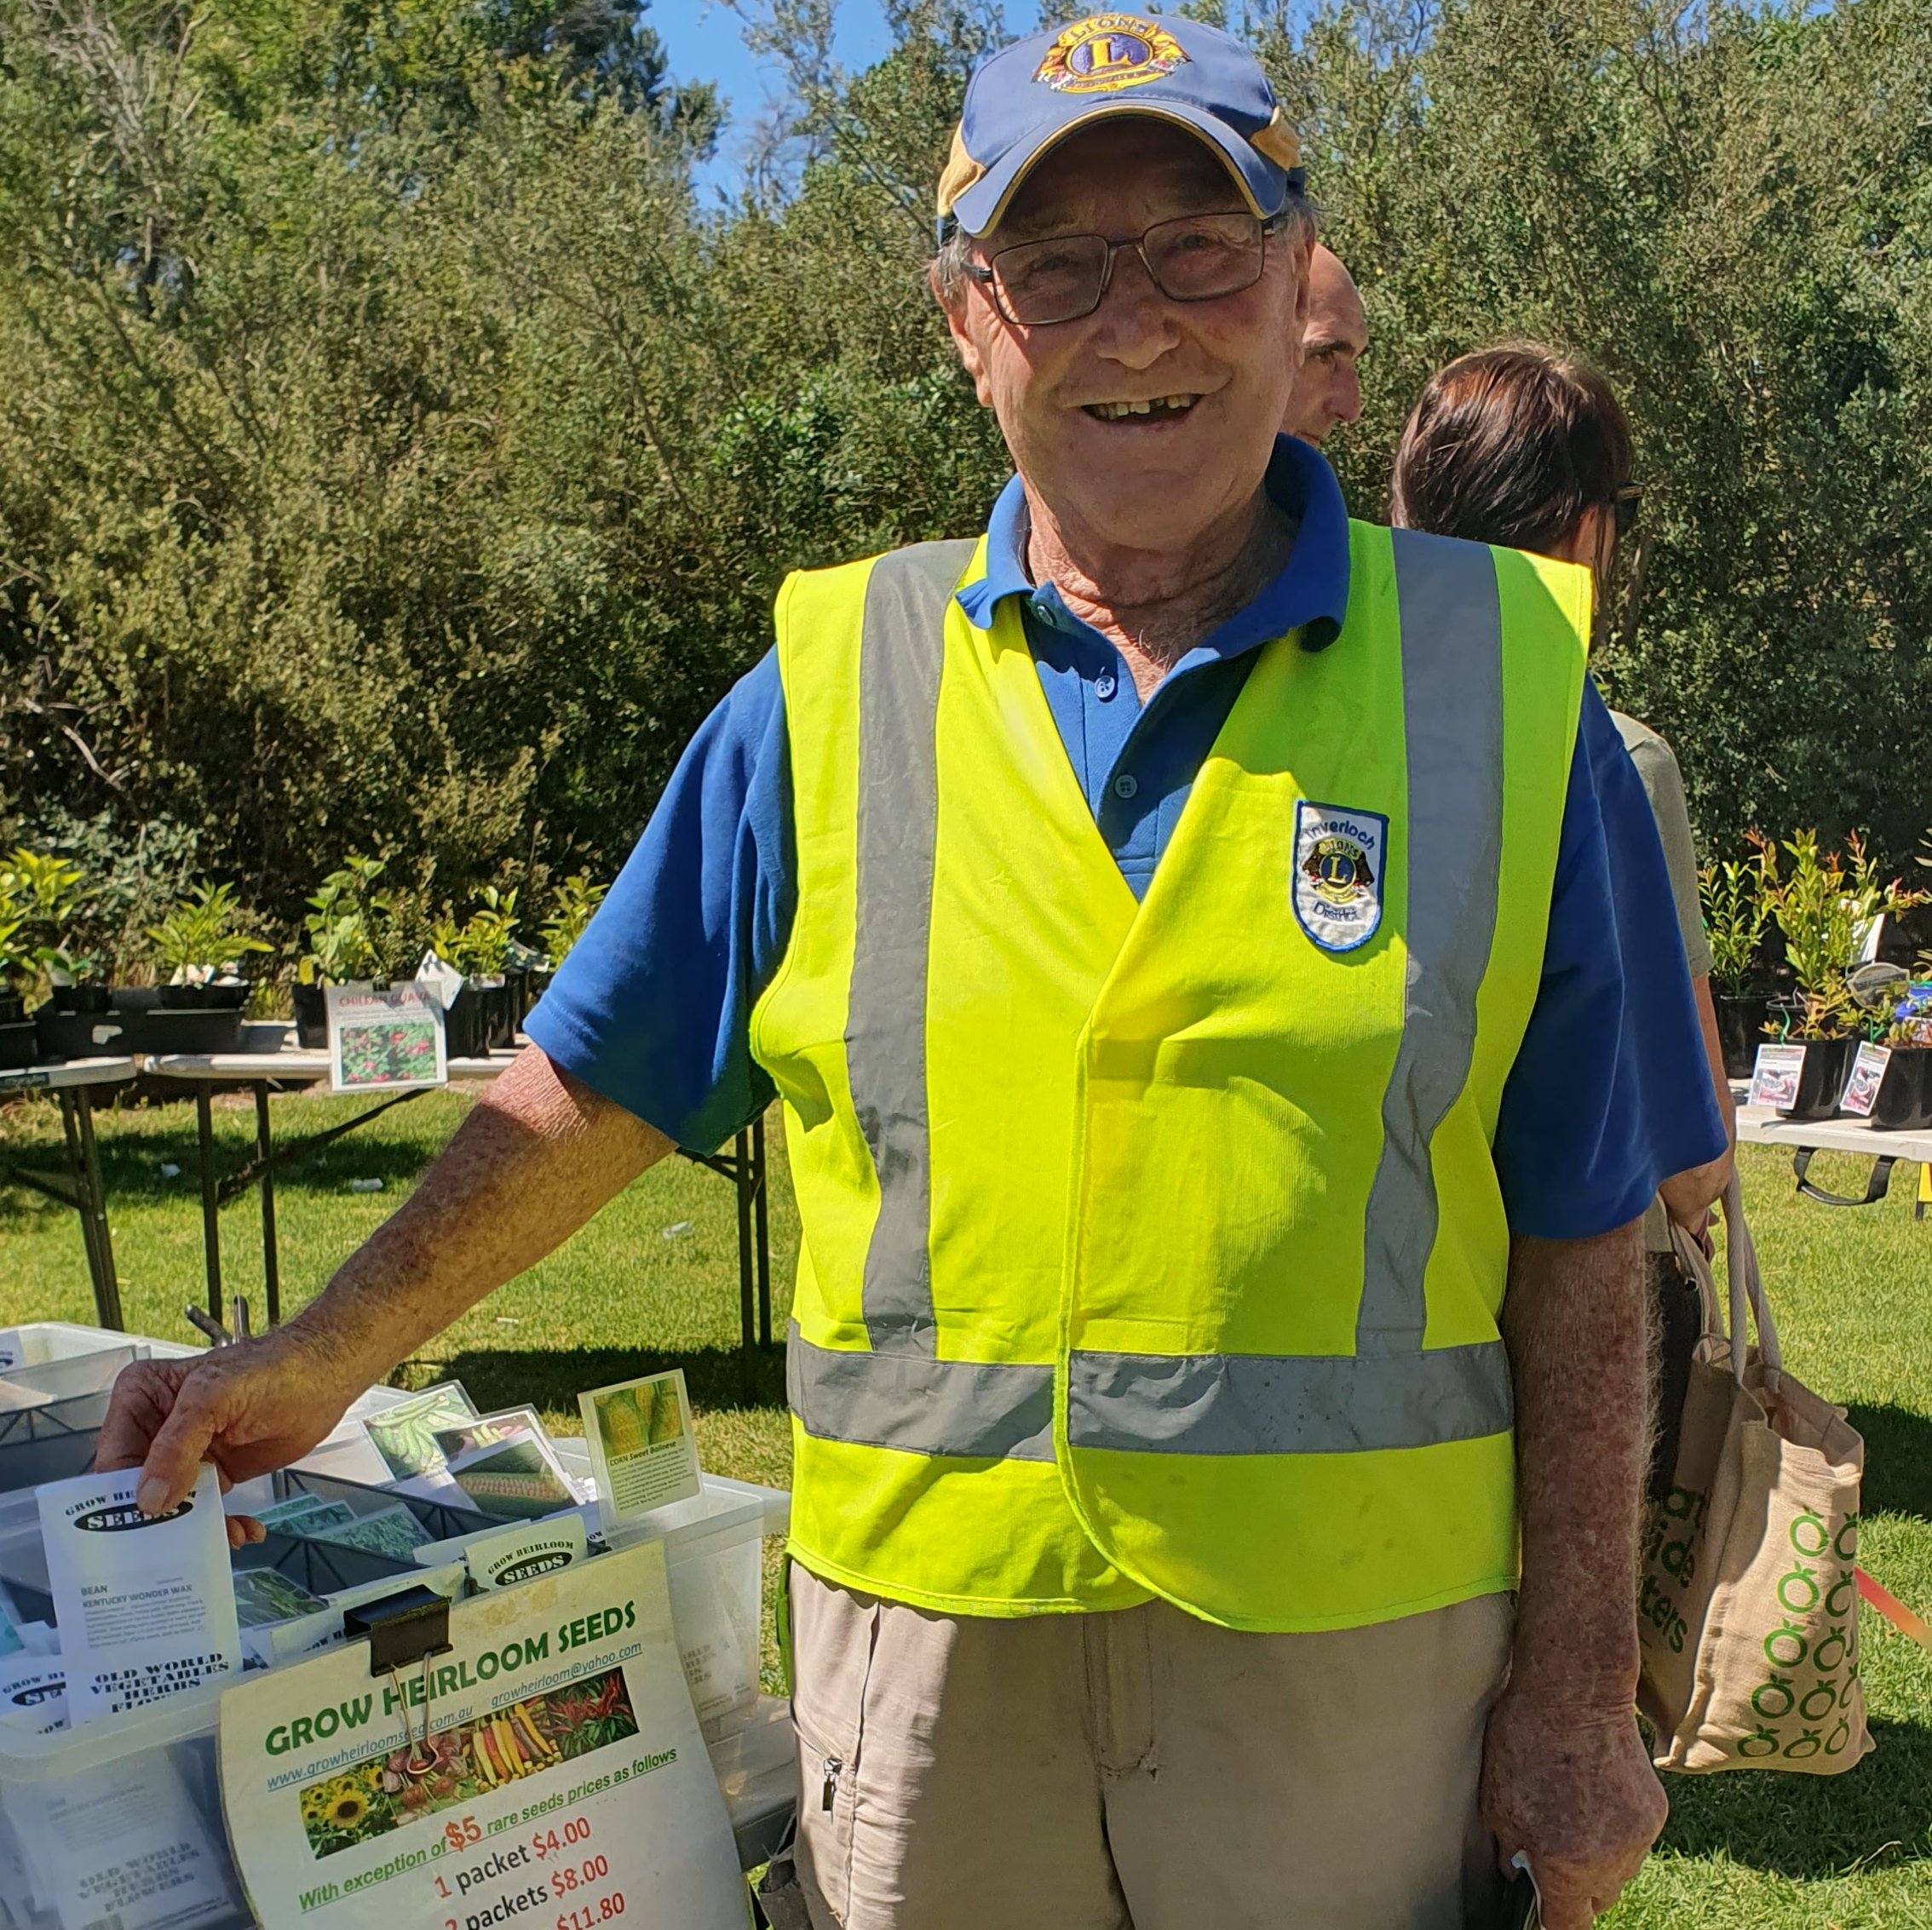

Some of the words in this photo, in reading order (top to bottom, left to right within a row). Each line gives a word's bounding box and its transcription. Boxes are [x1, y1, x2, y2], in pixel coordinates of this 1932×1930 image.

[1071, 15, 1150, 38] LIONS
[1088, 37, 1136, 71] L
[1306, 820, 1376, 850] Inverloch
[1327, 856, 1348, 885] L
[1313, 901, 1363, 922] District
[609, 1456, 629, 1467] CORN
[630, 1449, 649, 1461] Sweet
[65, 1496, 106, 1516] GROW
[487, 1552, 514, 1575] GROW
[515, 1541, 573, 1557] HEIRLOOM
[503, 1555, 565, 1583] SEEDS
[81, 1585, 107, 1596] BEAN
[83, 1595, 127, 1608] KENTUCKY
[129, 1588, 169, 1601] WONDER
[170, 1584, 193, 1595] WAX
[90, 1662, 229, 1695] VEGETABLES
[95, 1669, 138, 1683] OLD
[145, 1653, 222, 1674] WORLD
[265, 1694, 373, 1756] GROW
[382, 1632, 549, 1717] HEIRLOOM
[558, 1600, 635, 1653] SEEDS
[492, 1643, 641, 1708] growheirloom@yahoo.com
[2, 1676, 42, 1694] GROW
[124, 1679, 201, 1700] HERBS
[299, 1883, 339, 1910] With
[343, 1849, 427, 1893] exception
[431, 1837, 446, 1857] of
[445, 1815, 481, 1852] $5
[487, 1812, 519, 1834] rare
[522, 1793, 564, 1821] seeds
[567, 1776, 610, 1805] prices
[614, 1767, 630, 1784] as
[632, 1748, 677, 1775] follows
[434, 1875, 452, 1898] 1
[456, 1845, 531, 1896] packet
[532, 1817, 591, 1860] $4.00
[466, 1885, 549, 1930] packets
[551, 1855, 609, 1898] $8.00
[556, 1893, 625, 1930] $11.80
